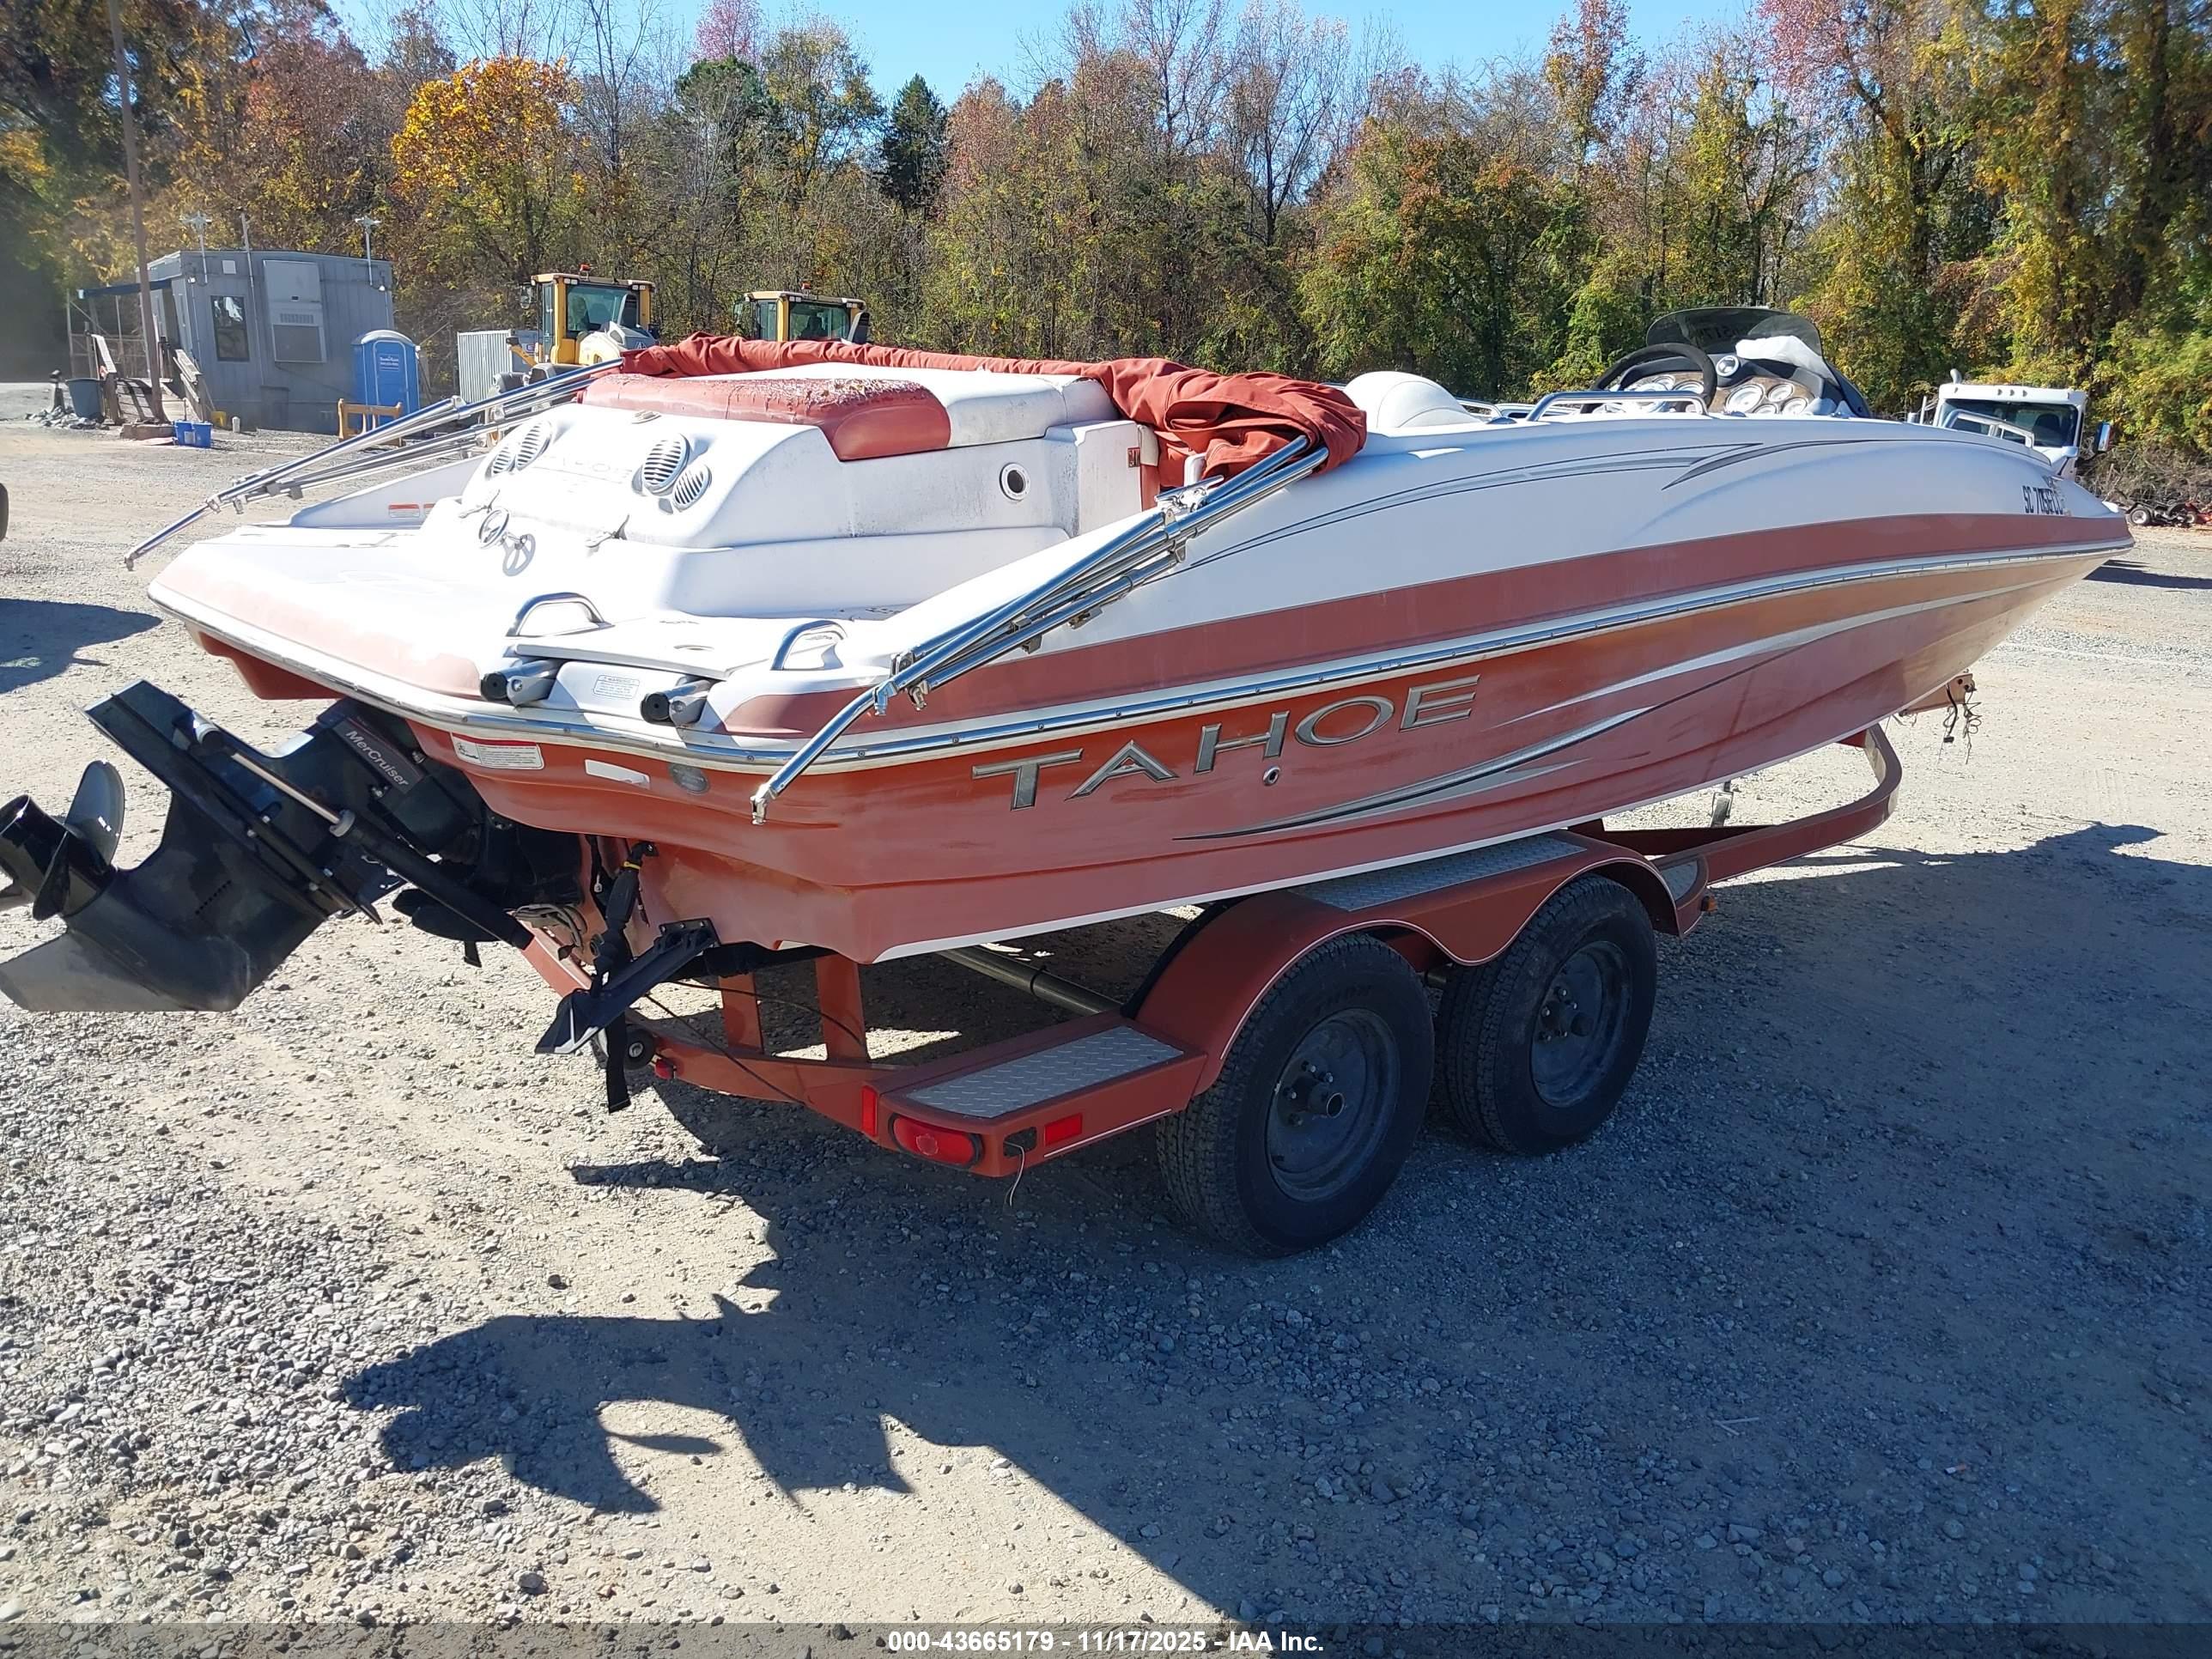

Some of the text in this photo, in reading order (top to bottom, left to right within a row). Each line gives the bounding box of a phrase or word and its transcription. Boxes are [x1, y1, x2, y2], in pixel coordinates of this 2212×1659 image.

[2021, 485, 2034, 514] SC
[344, 730, 410, 787] MerCruiser
[970, 674, 1481, 811] TAHOE
